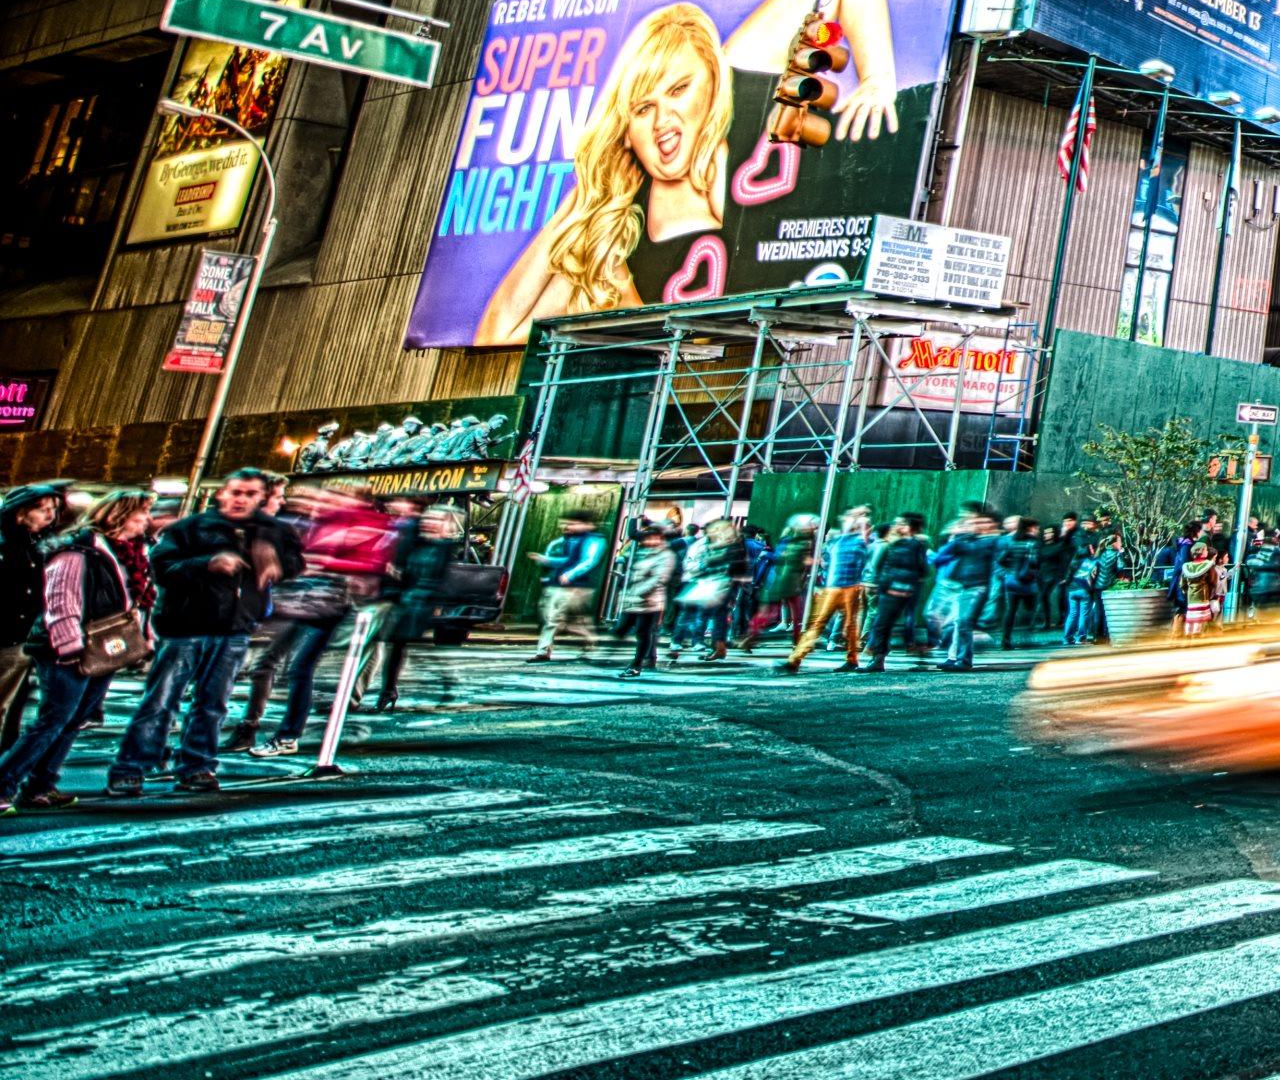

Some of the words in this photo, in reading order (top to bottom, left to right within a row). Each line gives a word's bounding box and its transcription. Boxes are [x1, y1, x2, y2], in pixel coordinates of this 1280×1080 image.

[259, 10, 289, 41] 7
[1247, 11, 1263, 31] 13
[476, 27, 607, 97] SUPER
[455, 85, 595, 170] FUN
[438, 162, 576, 238] NIGHT
[779, 216, 846, 240] PREMIERES
[846, 215, 872, 236] OCT
[757, 237, 850, 262] WEDNESDAYS
[198, 277, 232, 292] WALLS
[200, 265, 233, 280] SOME
[189, 301, 217, 315] TALK
[924, 376, 957, 389] YORK
